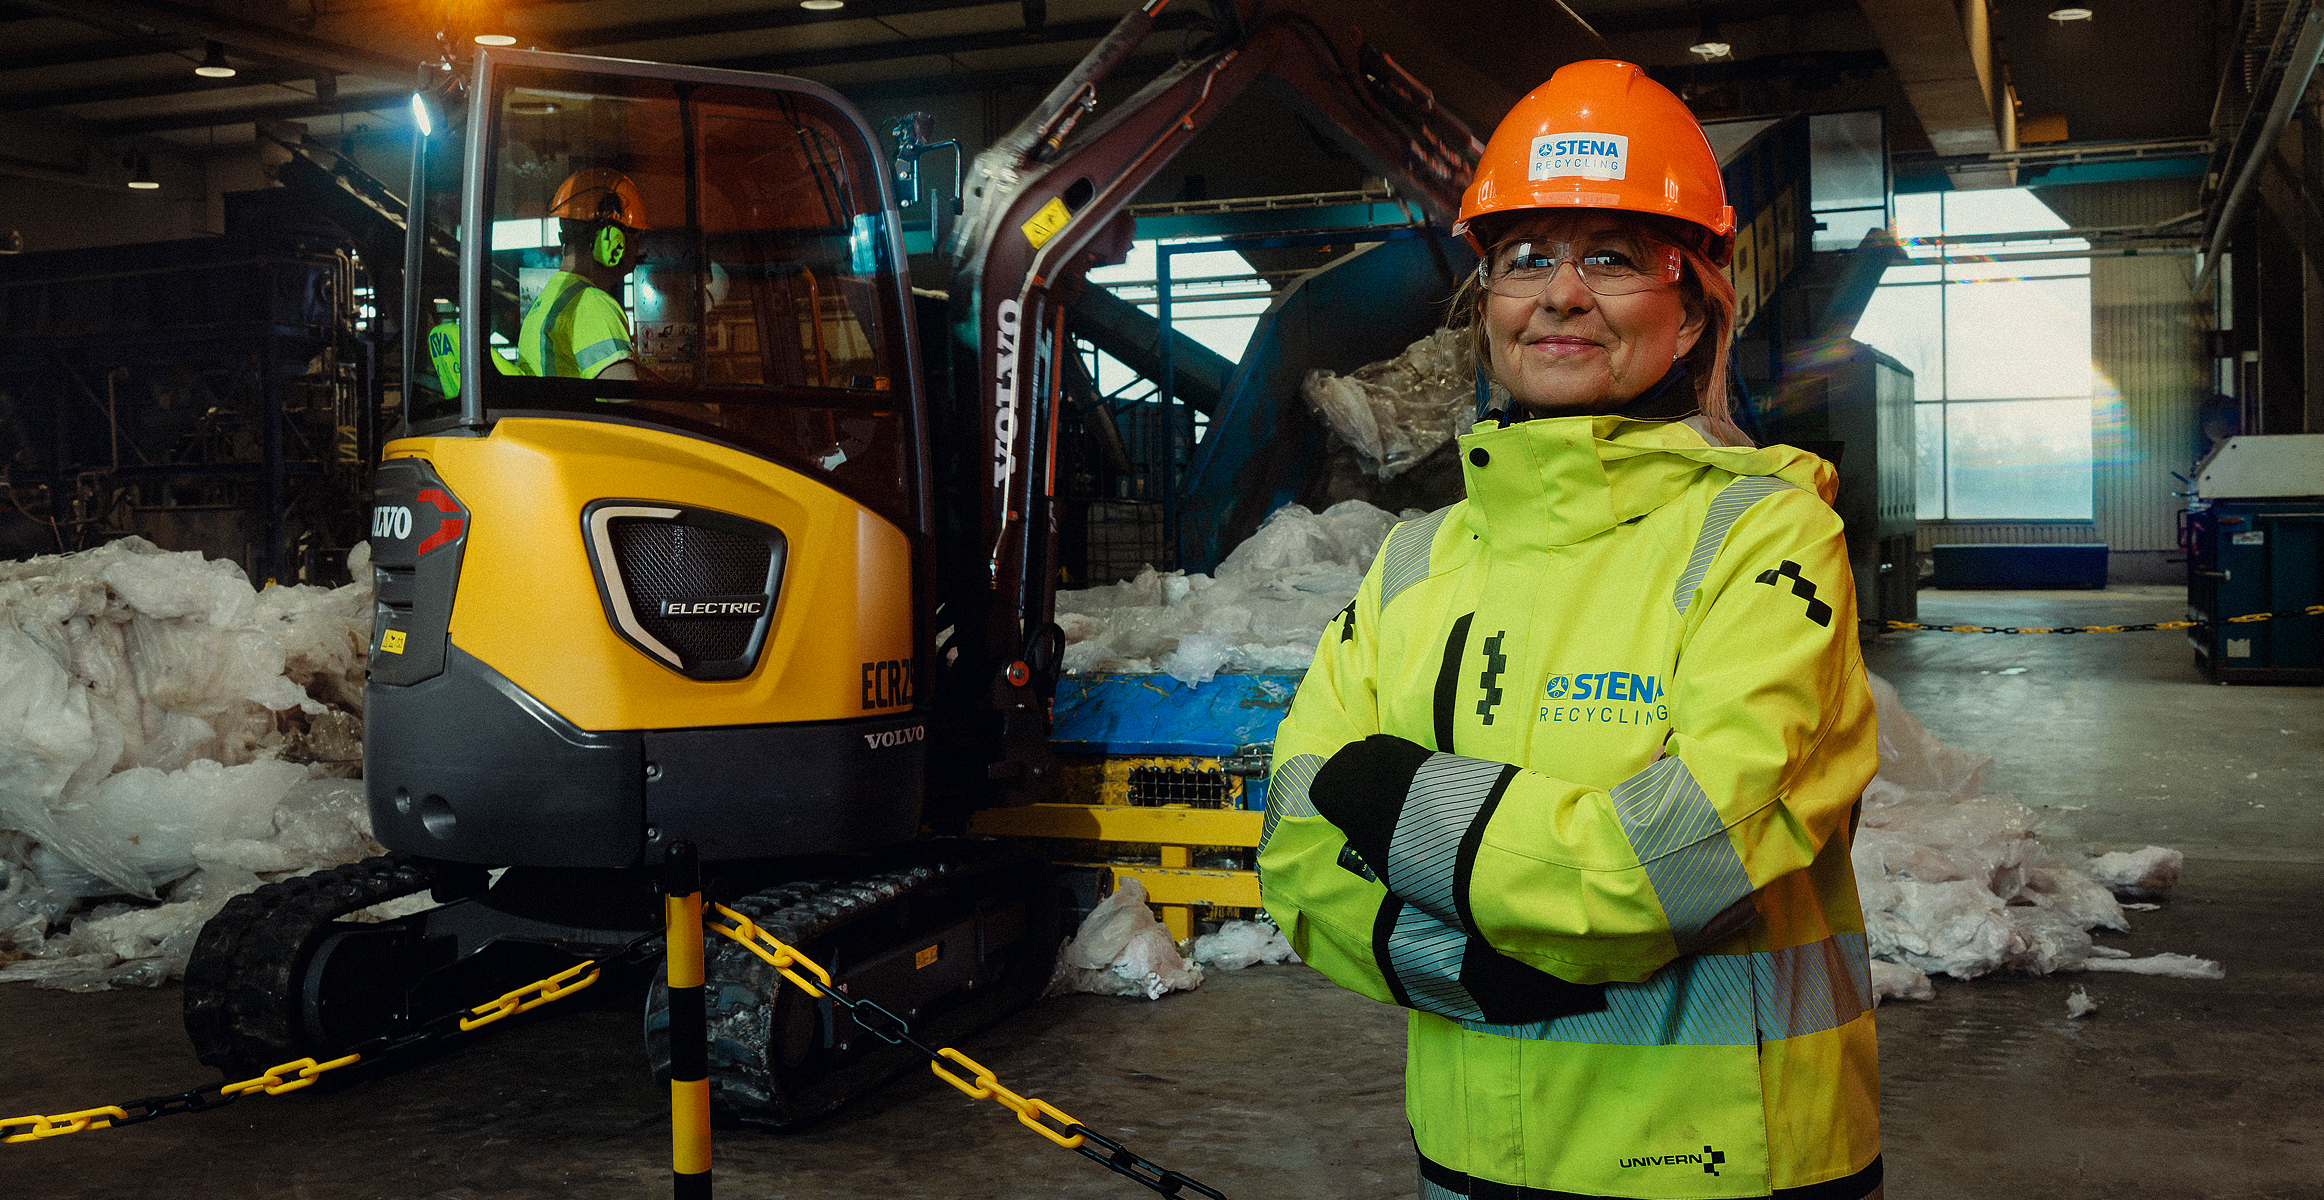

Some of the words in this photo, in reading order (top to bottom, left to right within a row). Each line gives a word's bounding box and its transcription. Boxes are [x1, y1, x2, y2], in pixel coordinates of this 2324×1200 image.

[1555, 140, 1619, 158] STENA
[1535, 158, 1618, 171] RECYCLING
[993, 299, 1021, 488] VOLVO
[372, 506, 412, 540] LVO
[668, 602, 761, 614] ELECTRIC
[1539, 705, 1668, 725] RECYCLING
[864, 725, 925, 750] VOLVO
[1619, 1153, 1703, 1168] UNIVERN
